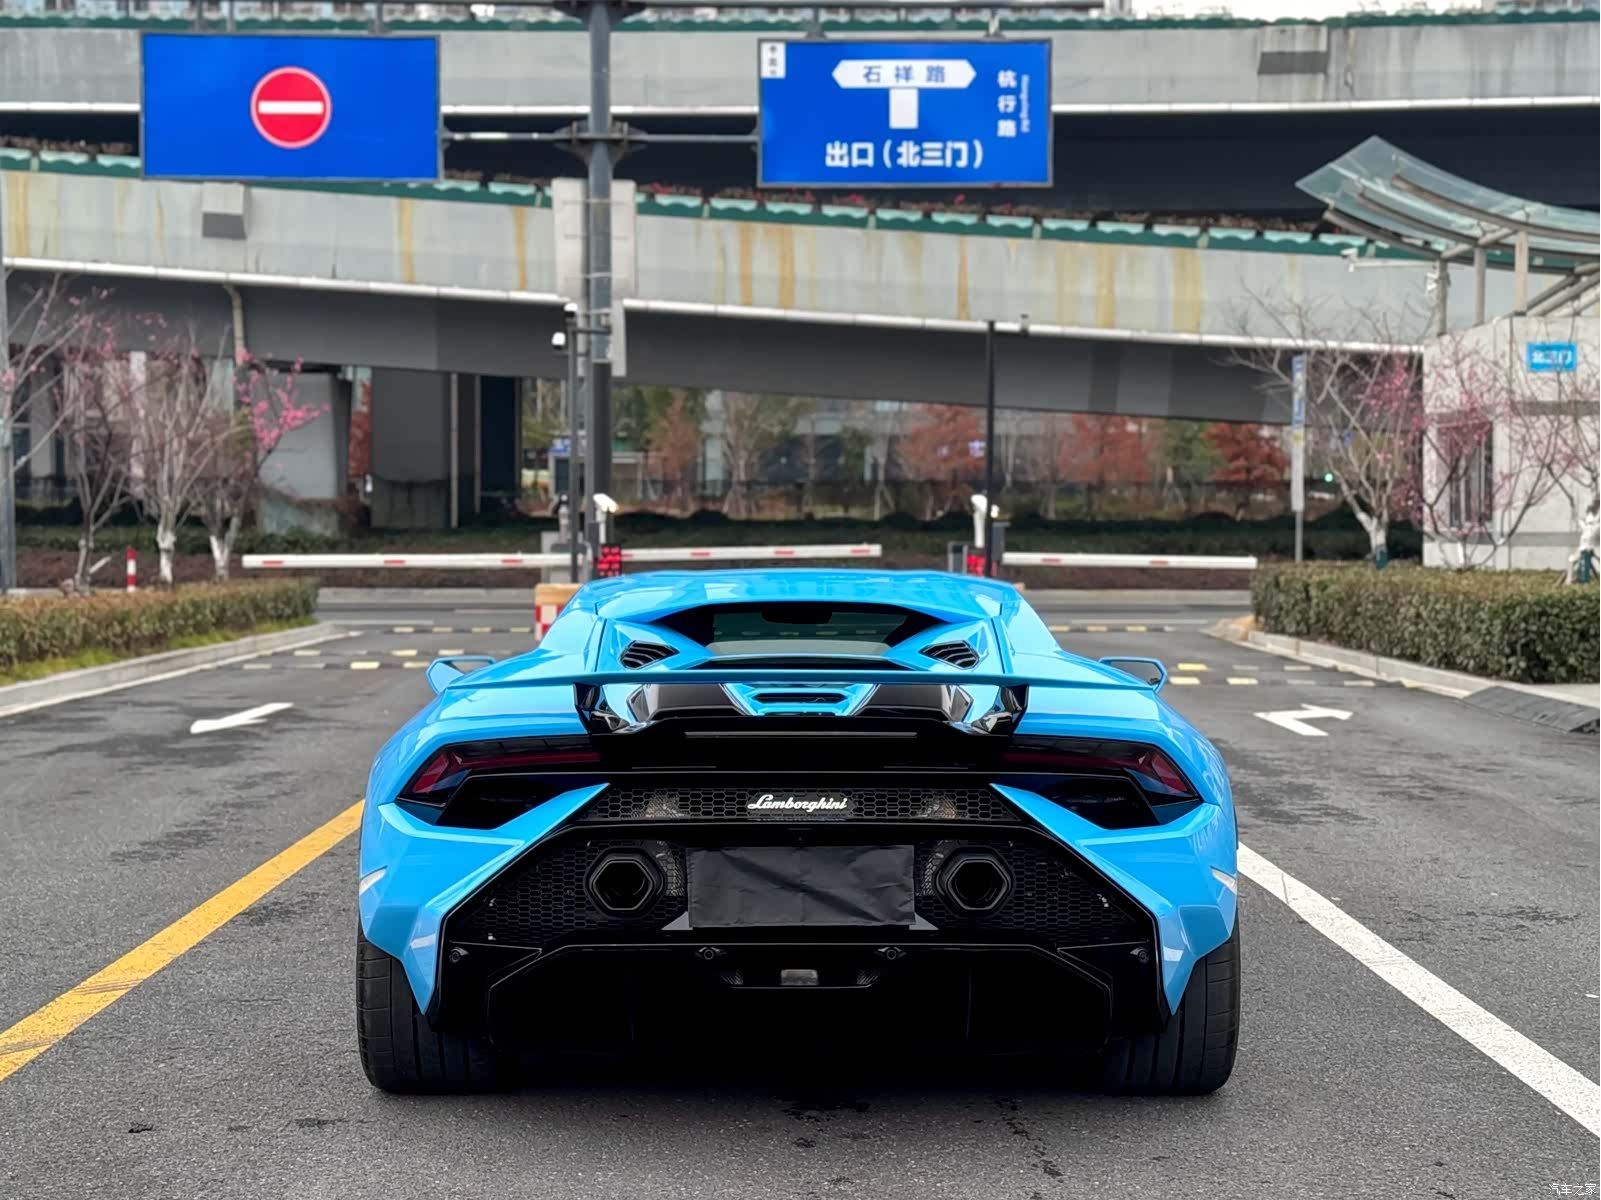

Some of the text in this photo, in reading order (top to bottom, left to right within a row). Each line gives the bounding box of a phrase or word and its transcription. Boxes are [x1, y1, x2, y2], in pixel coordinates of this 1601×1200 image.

[863, 65, 945, 83] 石祥路
[997, 70, 1017, 137] 杭行路
[747, 794, 848, 813] Lamborghini
